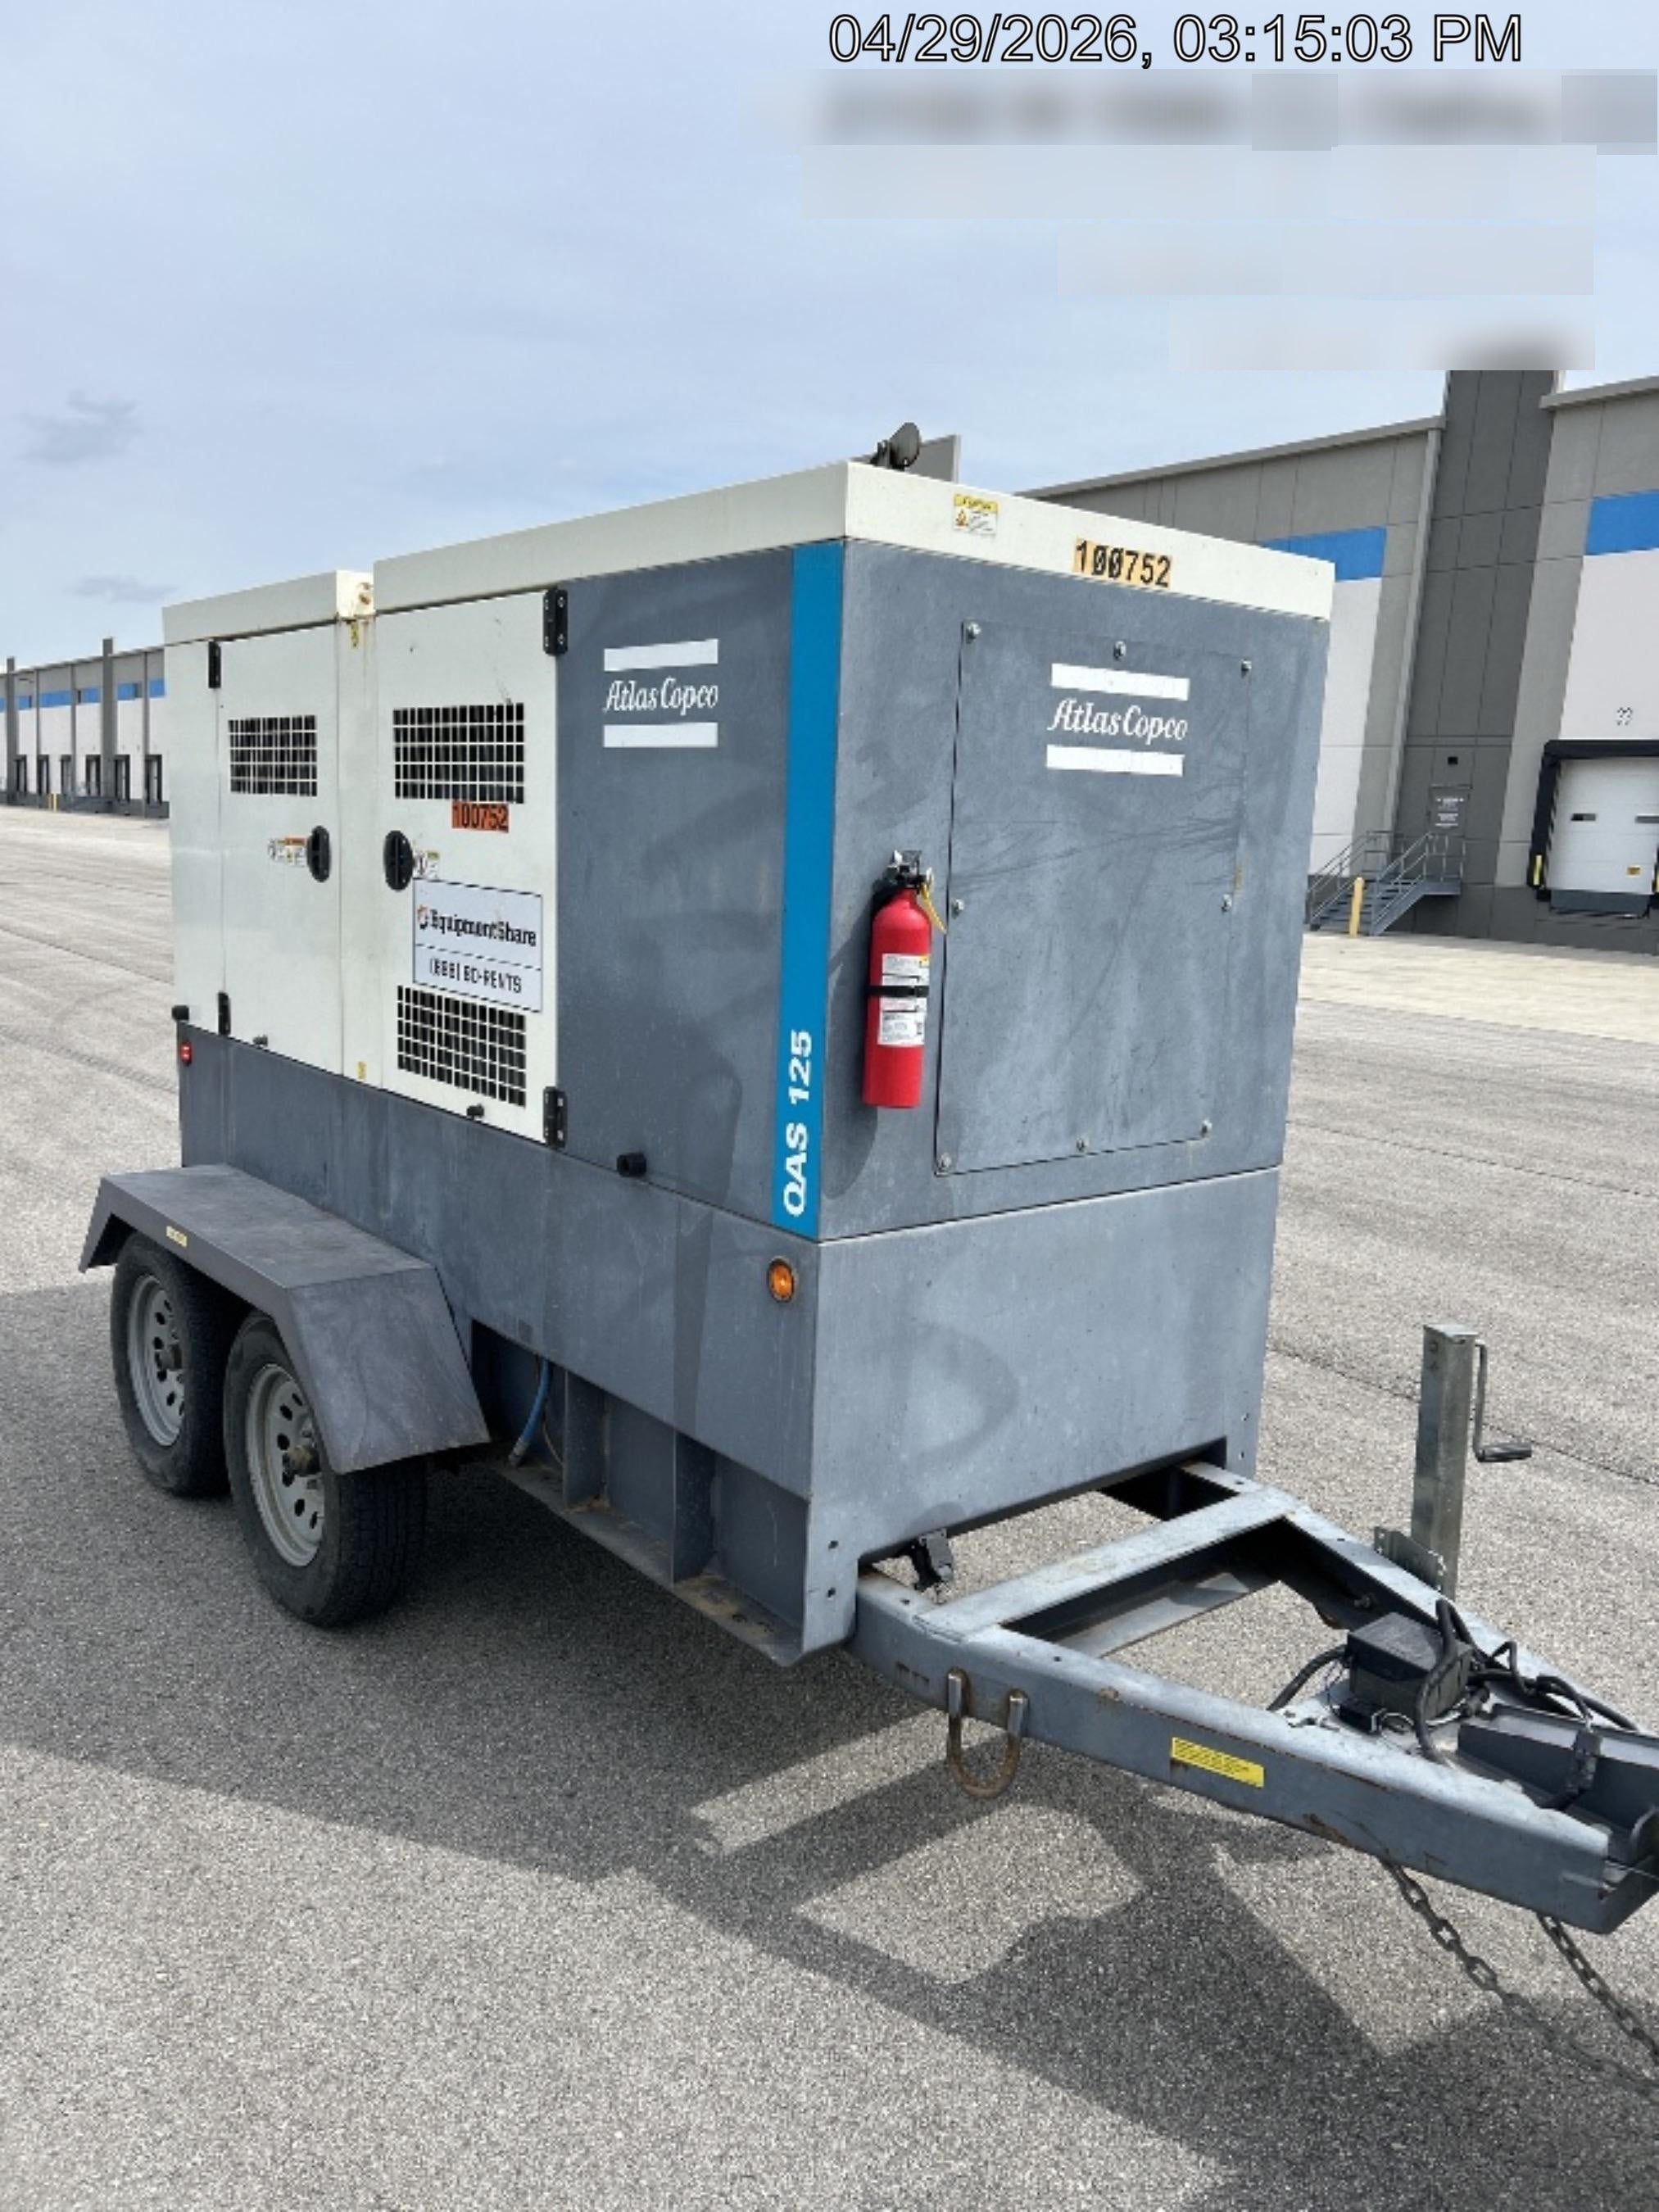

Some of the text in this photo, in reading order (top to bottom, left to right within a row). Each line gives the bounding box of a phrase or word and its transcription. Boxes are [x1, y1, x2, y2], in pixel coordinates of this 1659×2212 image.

[1076, 540, 1172, 587] 100752
[603, 676, 718, 716] Atlas Copco
[1047, 698, 1188, 746] Atlas Copco
[452, 802, 508, 830] 100752
[430, 909, 537, 947] EquipmentShare
[783, 1029, 813, 1217] QAS 125
